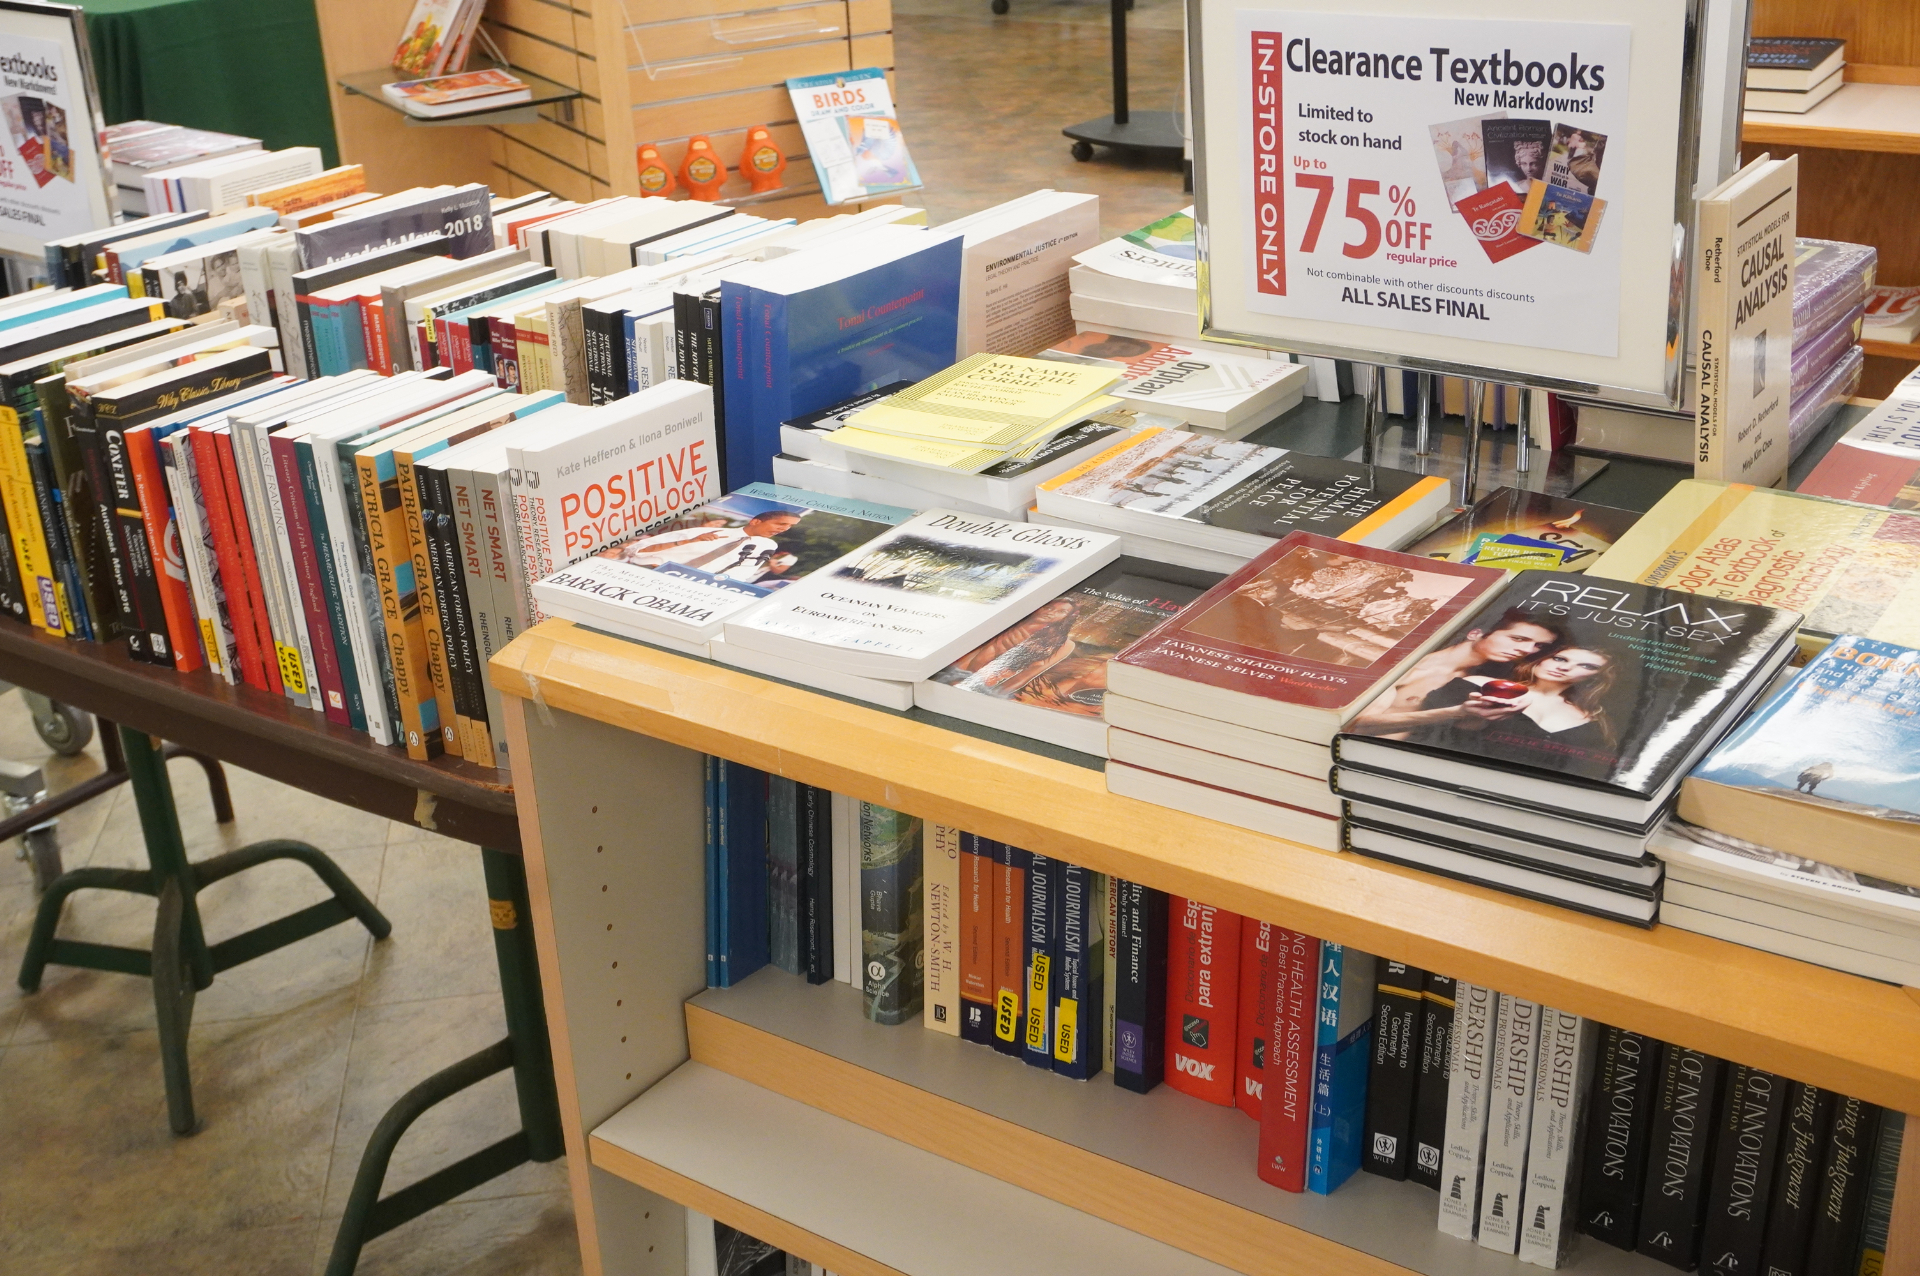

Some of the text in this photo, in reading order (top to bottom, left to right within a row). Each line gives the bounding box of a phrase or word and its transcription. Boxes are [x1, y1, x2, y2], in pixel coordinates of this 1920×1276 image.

[1286, 37, 1605, 91] Clearance Textbooks
[813, 89, 866, 108] BIRDS
[1299, 103, 1373, 123] Limited to
[1454, 88, 1594, 114] New Markdowns!
[1299, 129, 1402, 151] stock on hand
[1257, 39, 1280, 289] IN-STORE ONLY
[1294, 156, 1327, 171] Up to
[1551, 176, 1568, 188] WAR
[1553, 163, 1571, 175] WHY
[444, 214, 484, 239] 2018
[1295, 173, 1381, 260] 75
[1386, 219, 1431, 250] OFF
[986, 238, 1057, 272] ENVIRONMENTAL JUSTICE
[1387, 251, 1457, 269] regular price
[1713, 237, 1723, 283] Retherford
[1741, 234, 1785, 288] CAUSAL
[1307, 267, 1535, 304] Not combinable with other discounts discounts
[1342, 287, 1490, 321] ALL SALES FINAL
[1734, 264, 1788, 330] ANALYSIS
[426, 314, 434, 341] PRIMER
[764, 304, 772, 329] Tonal
[837, 288, 925, 331] Tonal Counterpoint
[735, 296, 744, 380] Tonal Counterpoint
[180, 386, 211, 402] Classics
[212, 376, 242, 393] Library
[967, 373, 1044, 388] CORRIE
[1000, 371, 1077, 386] RACHEL
[1025, 366, 1082, 379] NAME
[1128, 361, 1211, 396] Orphan
[1699, 329, 1712, 463] CAUSAL ANALYSIS
[556, 411, 703, 479] Kate Hefferon Ilona Boniwell
[1862, 425, 1896, 442] THIS
[105, 429, 129, 499] COXETER
[560, 439, 708, 531] POSITIVE
[259, 437, 285, 537] CASE FRAMING
[288, 485, 301, 527] Criticism
[1249, 477, 1302, 507] PEACE
[1273, 474, 1362, 525] POTENTIAL
[1277, 486, 1317, 506] FOR
[1309, 486, 1371, 523] HUMAN
[518, 494, 535, 551] POSITIVE
[564, 473, 708, 557] PSYCHOLOGY
[1343, 499, 1381, 518] THE
[455, 485, 482, 579] NET SMART
[481, 489, 508, 583] NET SMART
[927, 513, 1092, 553] Double Ghosts
[1704, 537, 1743, 566] Atlas
[100, 504, 131, 613] Autodesk Maya 2016
[399, 463, 446, 693] PATRICIA GRACE Chappy
[1708, 529, 1787, 589] Textbook of
[360, 467, 410, 697] PATRICIA GRACE Chappy
[428, 535, 457, 670] AMERICAN FOREIGN POLICY
[549, 573, 637, 601] BARACK
[633, 596, 714, 622] OBAMA
[820, 592, 882, 609] OCEANIAN
[1083, 587, 1132, 604] The Value
[41, 580, 60, 627] USED
[334, 601, 348, 646] TRADITION
[443, 540, 474, 675] AMERICAN FOREIGN POLICY
[1516, 599, 1734, 645] IT'S JUST SEX
[1531, 580, 1745, 632] RELAX
[1161, 638, 1348, 685] JAVANESE SHADOW PLAYS,
[1608, 631, 1690, 652] Understanding
[1628, 643, 1717, 664] Non-Possessive
[1639, 654, 1687, 667] Intimate
[289, 652, 302, 690] USED
[1152, 646, 1222, 669] JAVANESE
[1223, 663, 1276, 681] SELVES
[1279, 676, 1306, 687] Ward
[1645, 662, 1723, 682] Relationships
[1031, 870, 1047, 944] JOURNALISM
[1065, 878, 1082, 953] JOURNALISM
[930, 882, 941, 993] NEWTON-SMITH
[1108, 918, 1117, 959] HISTORY
[1131, 908, 1142, 984] and Finance
[1034, 955, 1046, 991] USED
[1199, 970, 1214, 1008] para
[1001, 995, 1013, 1035] USED
[1029, 1007, 1041, 1044] USED
[1273, 944, 1287, 1066] Best Practice Approach
[1059, 1024, 1071, 1054] USED
[1284, 962, 1304, 1121] HEALTH ASSESSMENT
[1377, 1004, 1391, 1065] Second Edition
[1389, 1016, 1401, 1058] Geometry
[1400, 1012, 1414, 1058] Introduction
[1493, 1017, 1507, 1090] PROFESSIONALS
[1175, 1053, 1216, 1082] VOX
[1318, 1053, 1331, 1097] 生活篇
[1664, 1064, 1677, 1112] EDITION
[1603, 1065, 1638, 1180] INNOVATIONS
[1662, 1084, 1701, 1201] INNOVATIONS
[1373, 1154, 1395, 1165] WILEY
[1490, 1168, 1514, 1179] Coppola
[1727, 1103, 1769, 1221] INNOVATIONS
[1786, 1132, 1815, 1209] Judgment
[1827, 1145, 1858, 1222] Judgment
